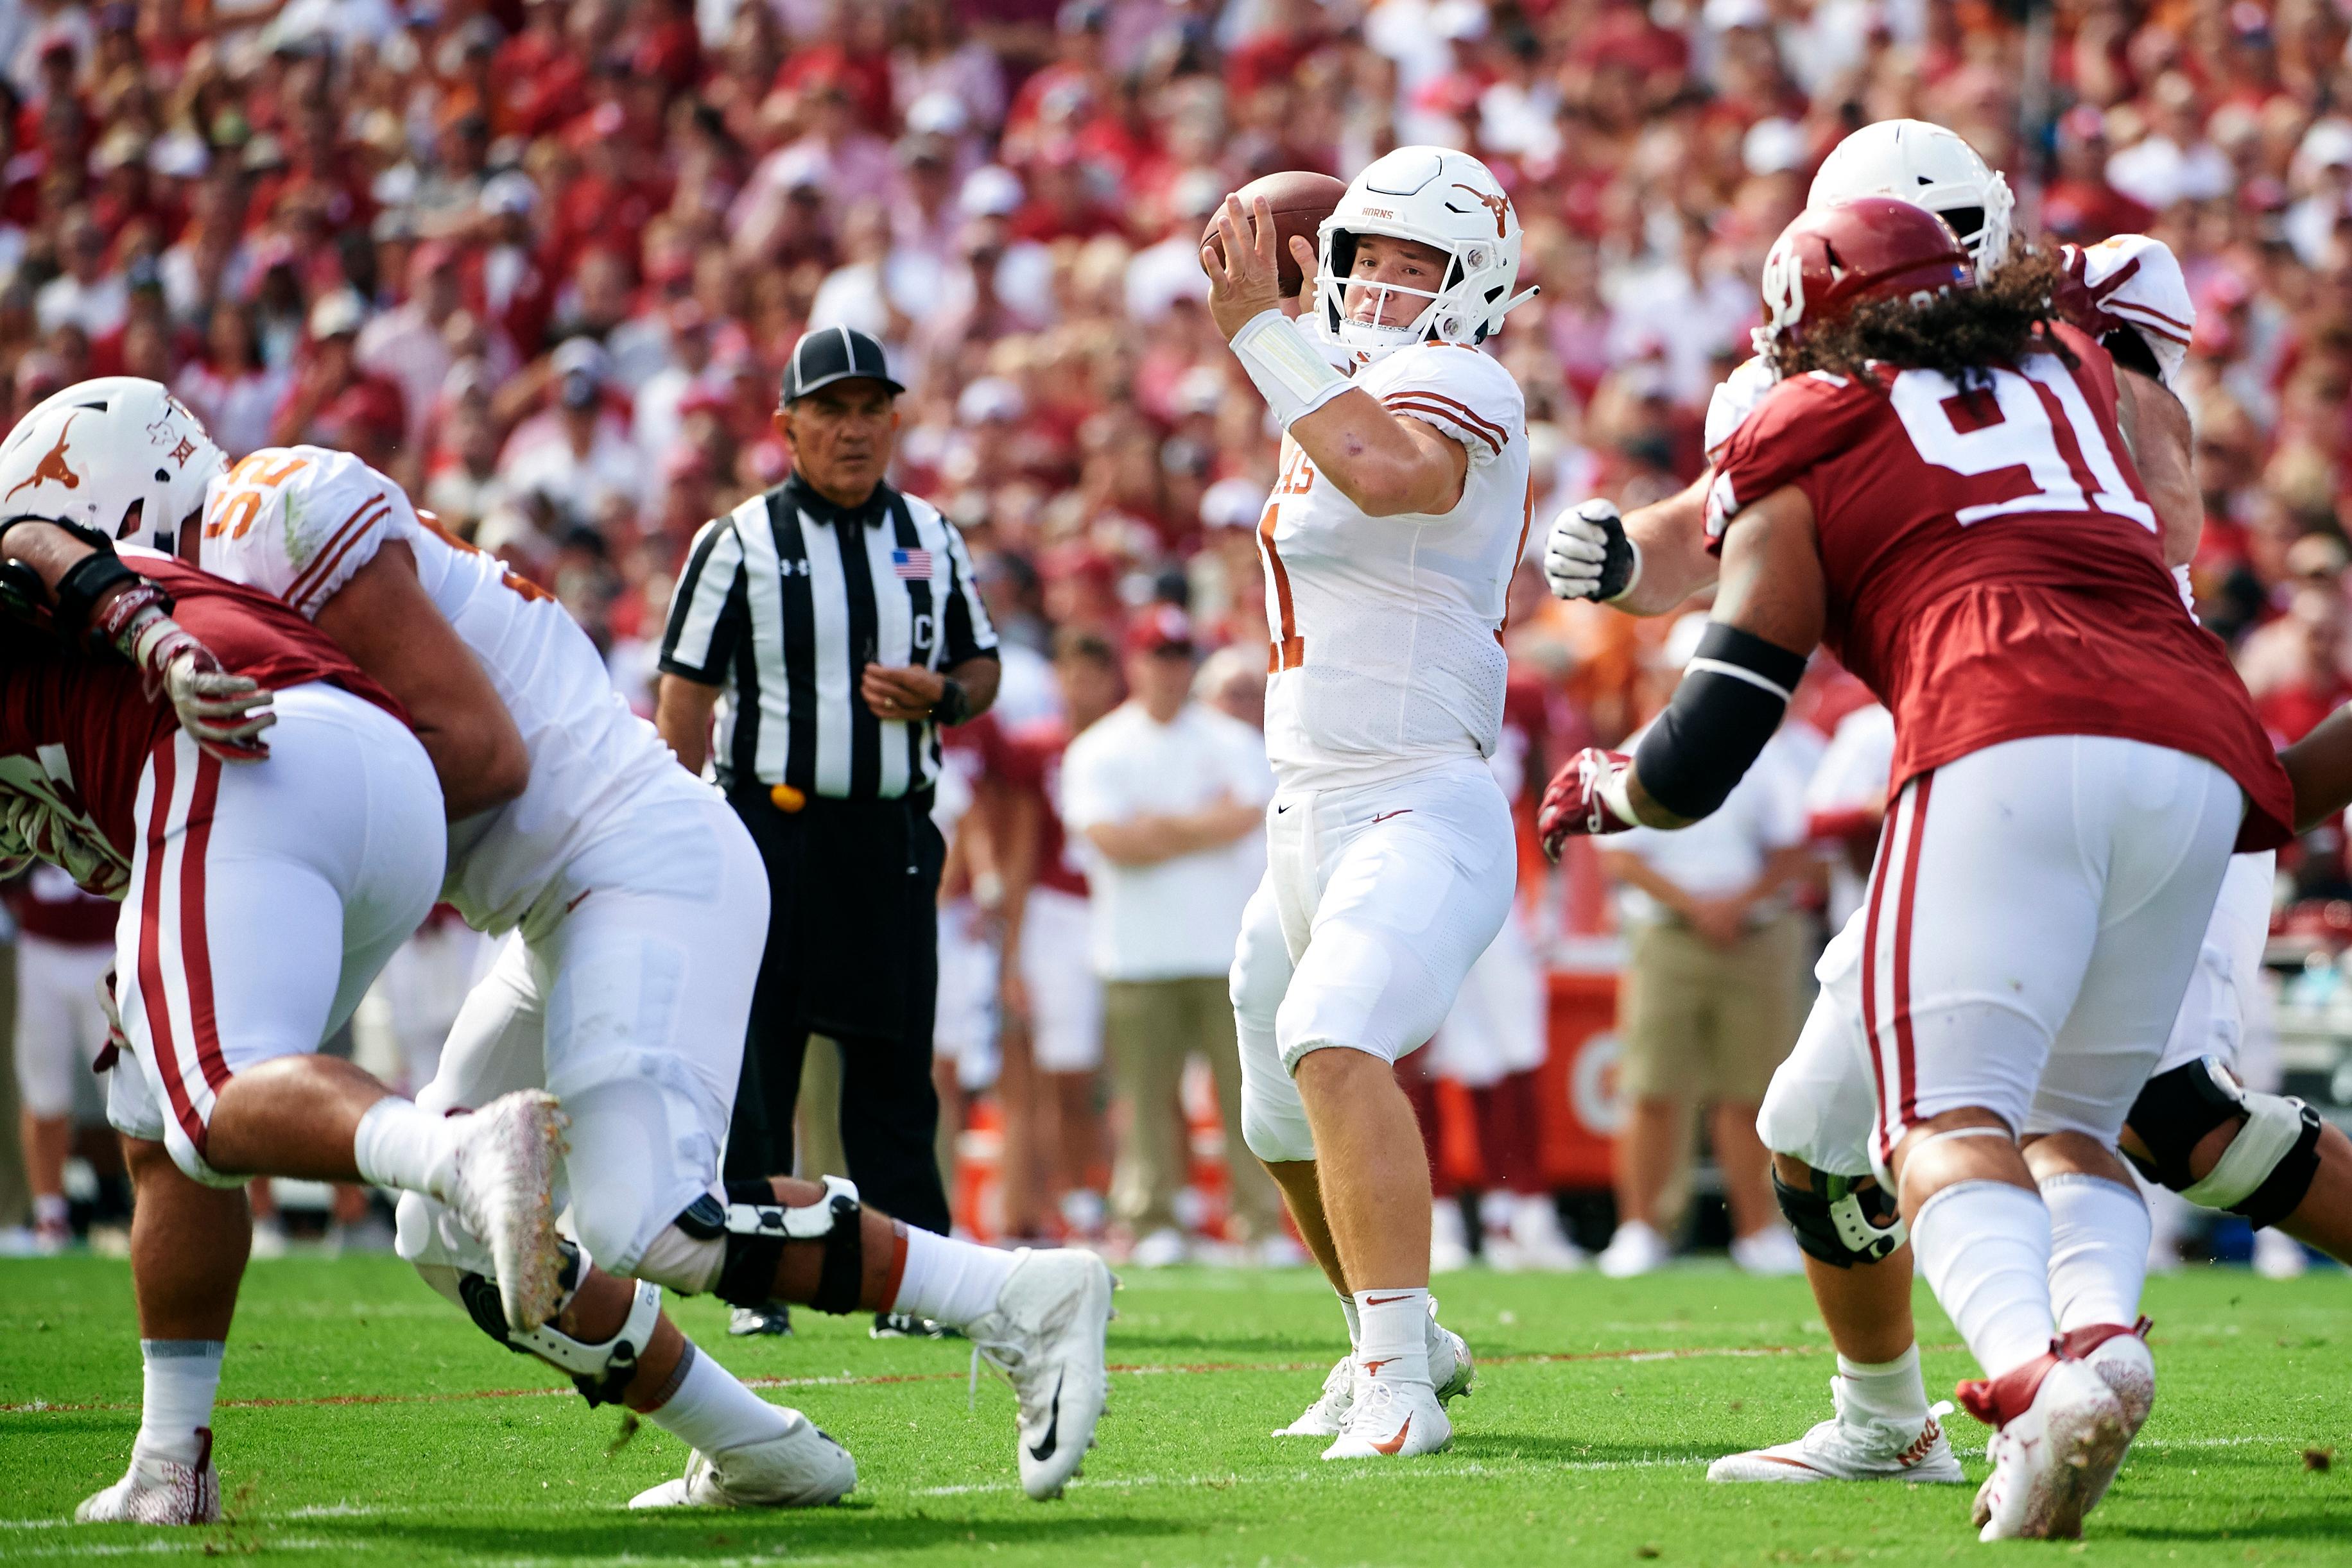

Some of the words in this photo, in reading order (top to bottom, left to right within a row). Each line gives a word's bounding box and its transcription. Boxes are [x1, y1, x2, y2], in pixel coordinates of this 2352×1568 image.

[1362, 207, 1394, 220] HORNS
[1890, 353, 2157, 535] 91
[1272, 451, 1314, 494] AS
[204, 454, 308, 540] 52
[914, 614, 935, 650] C
